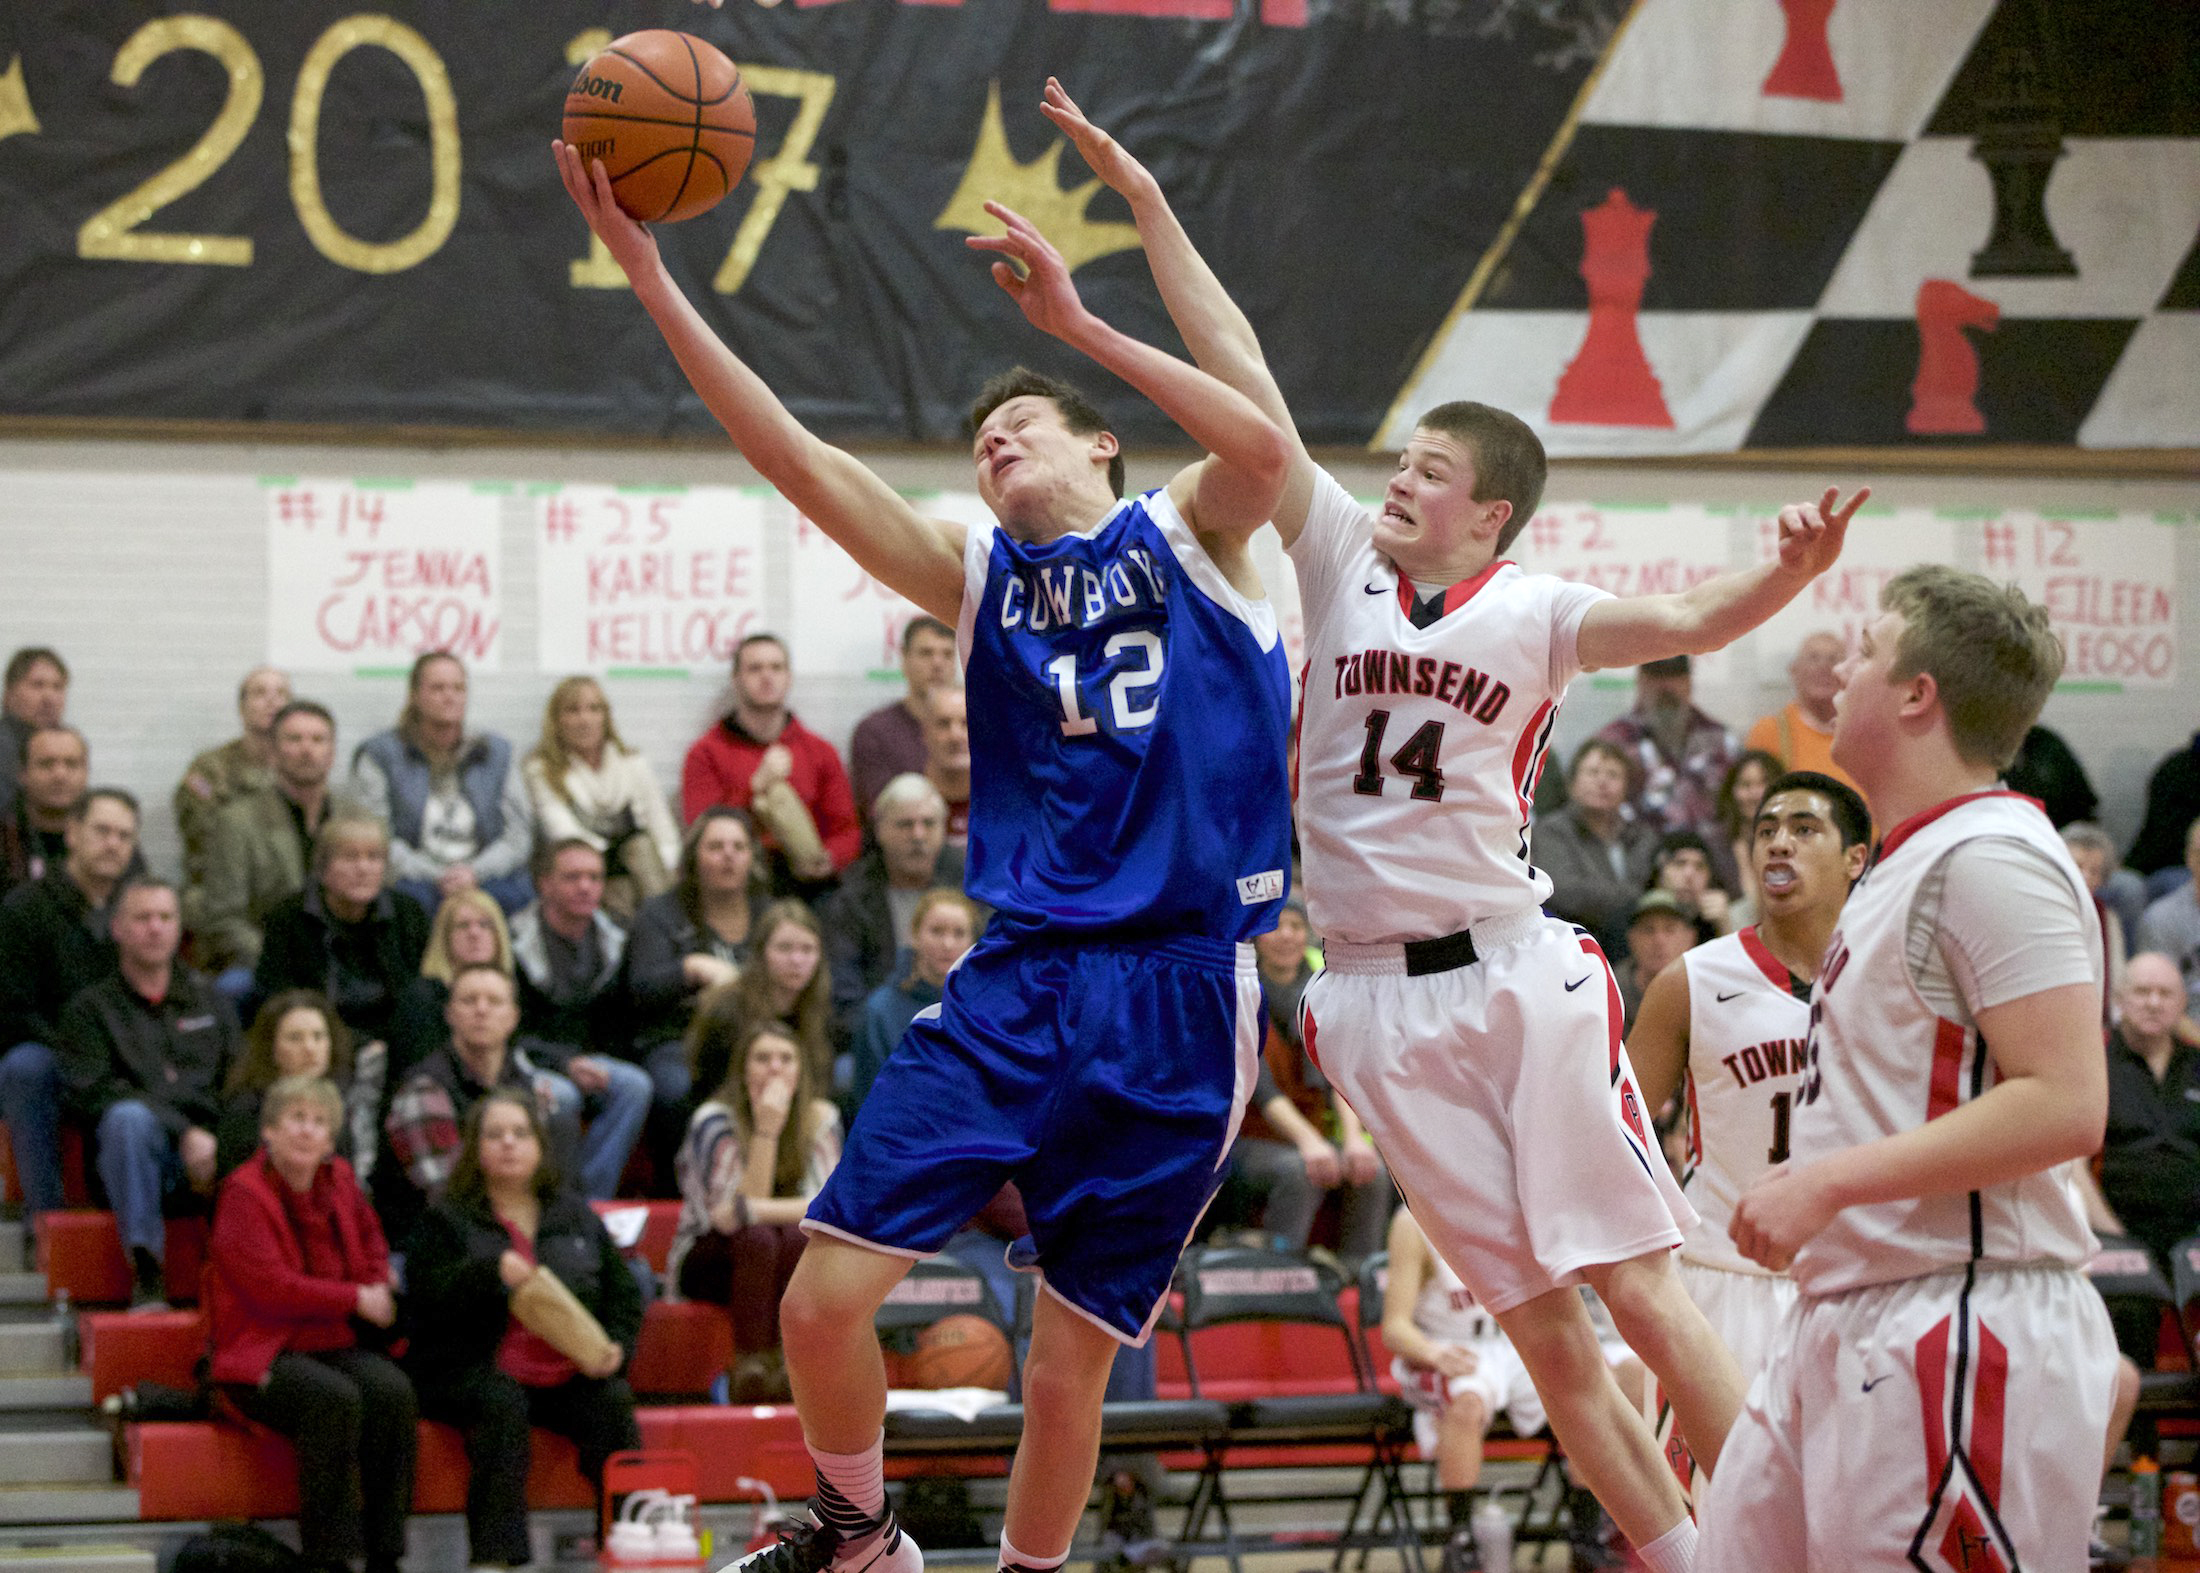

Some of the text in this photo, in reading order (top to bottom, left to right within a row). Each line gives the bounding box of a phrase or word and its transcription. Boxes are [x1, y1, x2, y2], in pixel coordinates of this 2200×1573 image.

[331, 549, 491, 599] JENNA
[586, 547, 753, 604] KARLEE
[1001, 547, 1166, 631] COWBOY
[2045, 575, 2171, 628] EILEEN
[315, 594, 500, 660] CARSON
[2057, 629, 2172, 679] LEOSO
[1048, 629, 1164, 737] 12
[1335, 649, 1511, 726] TOWNSEND
[1353, 708, 1445, 803] 14
[1721, 1037, 1808, 1090] TOWN
[1767, 1091, 1791, 1165] 1
